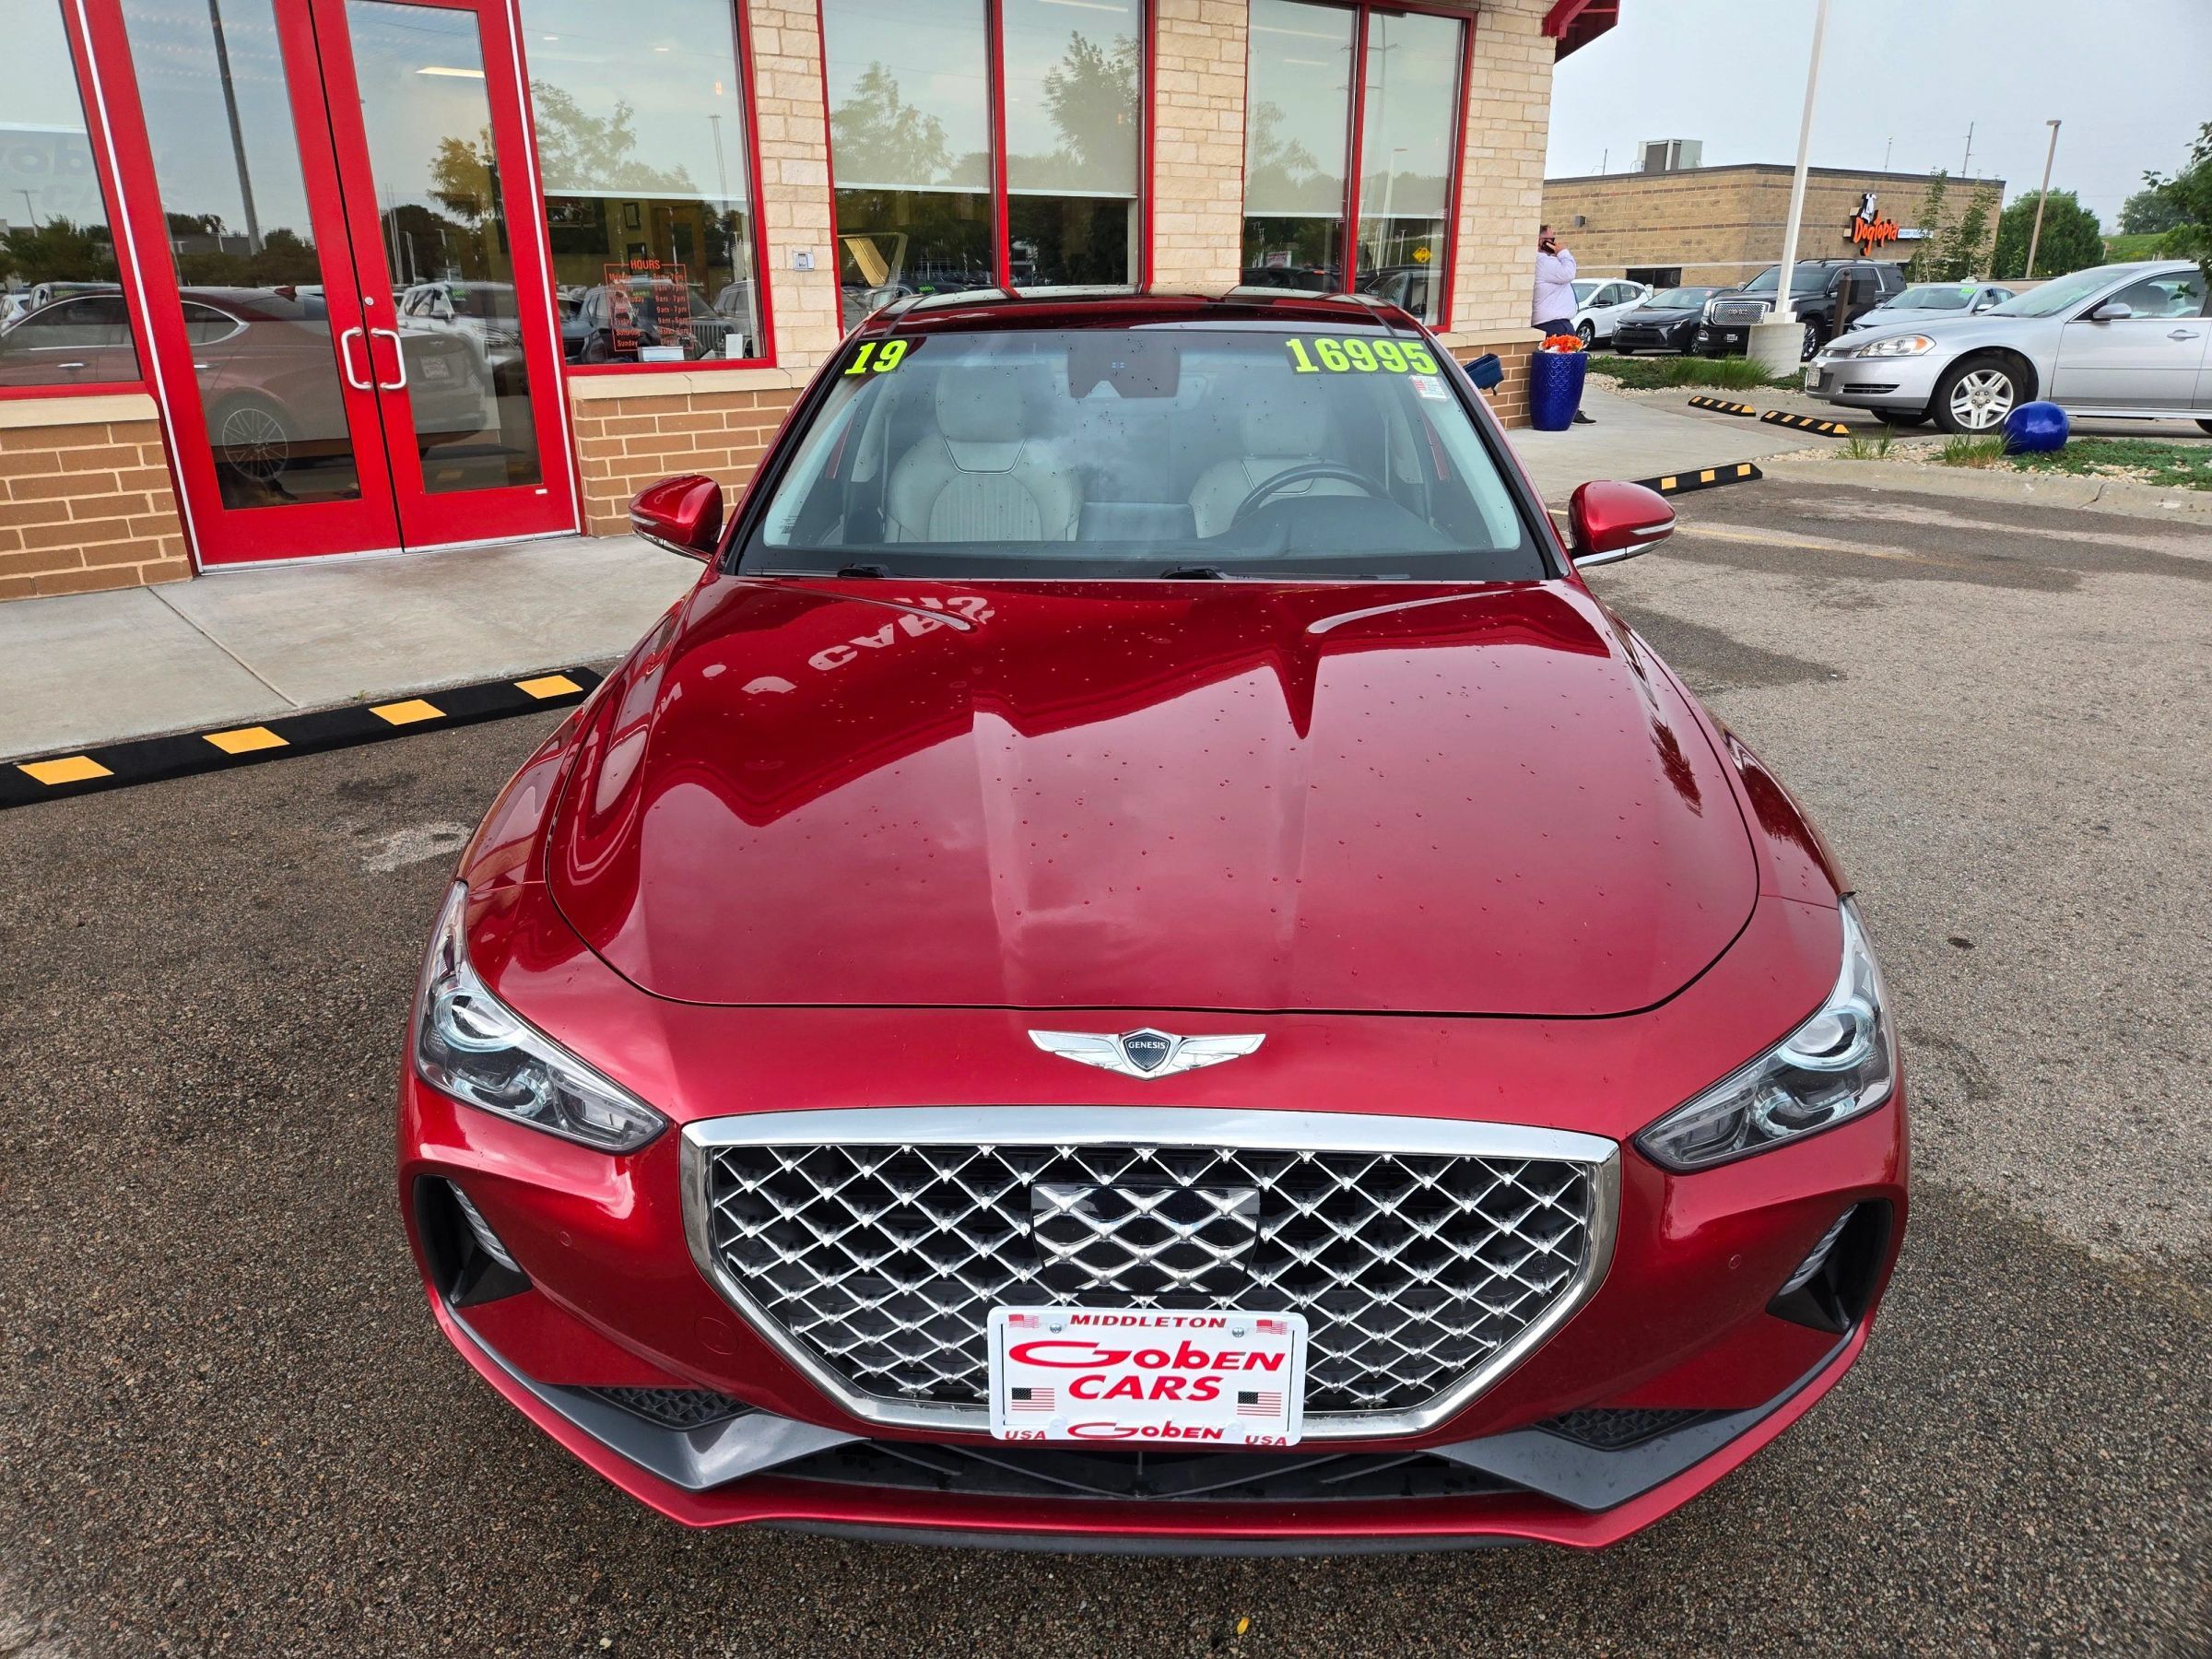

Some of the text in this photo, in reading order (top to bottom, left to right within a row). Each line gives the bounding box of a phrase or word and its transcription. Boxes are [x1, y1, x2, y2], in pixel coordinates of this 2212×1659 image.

[1853, 210, 1900, 256] Dogtopia
[629, 259, 661, 270] HOURS
[844, 339, 908, 375] 19
[1286, 337, 1439, 375] 16995
[1127, 1041, 1167, 1050] GENESIS
[1069, 1313, 1228, 1329] MIDDLETON
[1067, 1374, 1225, 1402] CARS
[1005, 1429, 1048, 1441] USA
[1244, 1433, 1288, 1447] USA
